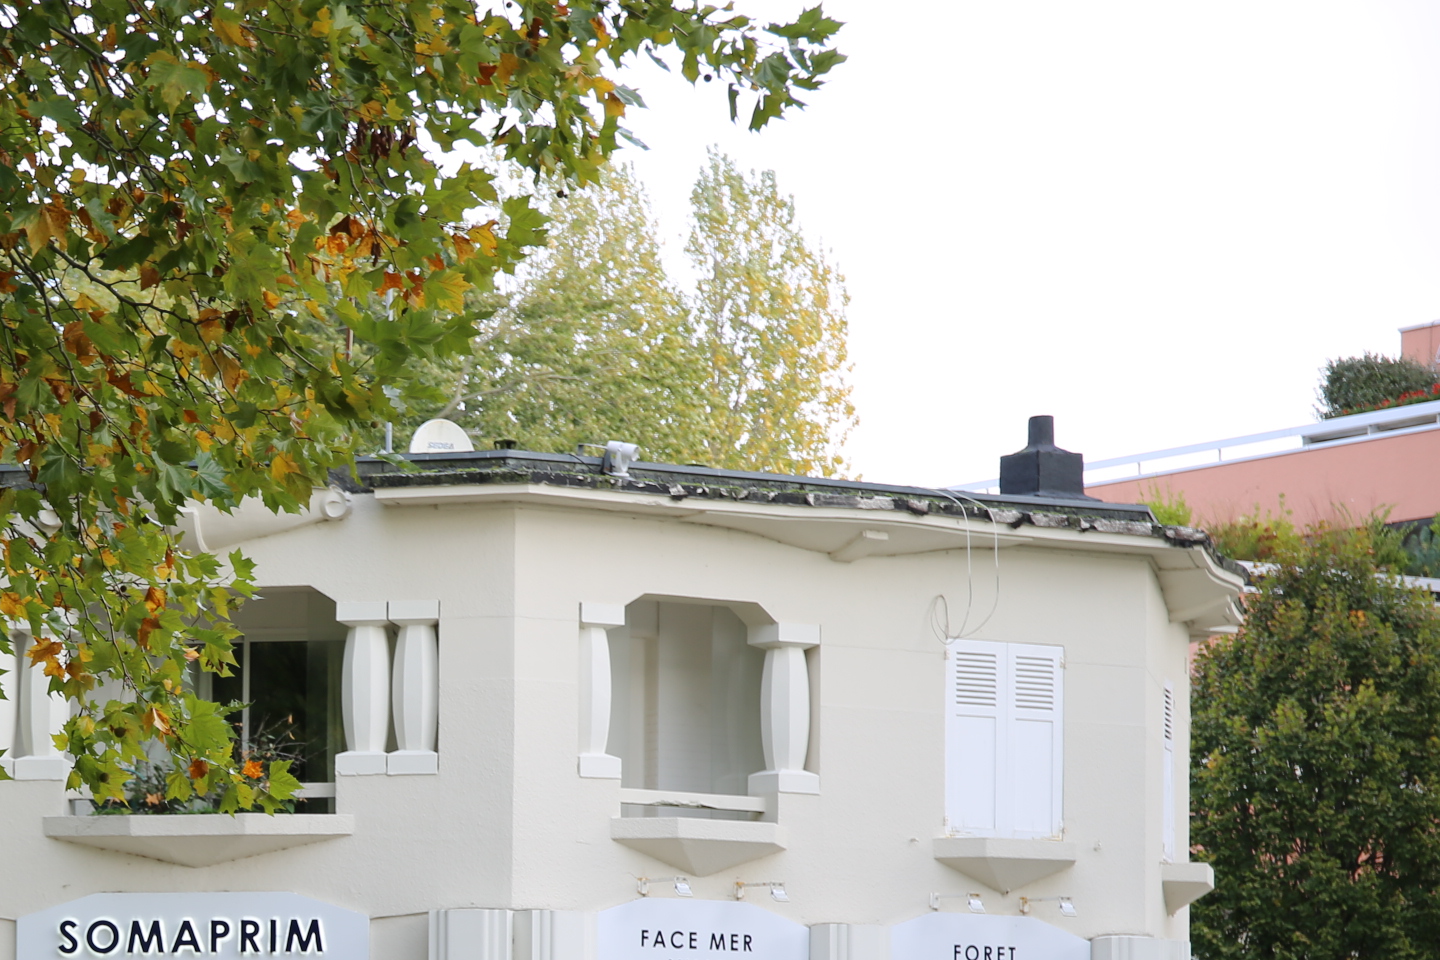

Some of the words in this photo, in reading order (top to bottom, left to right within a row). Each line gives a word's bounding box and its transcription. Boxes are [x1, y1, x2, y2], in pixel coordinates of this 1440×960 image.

[58, 919, 324, 955] SOMAPRIM
[641, 929, 698, 949] FACE
[709, 932, 753, 952] MER
